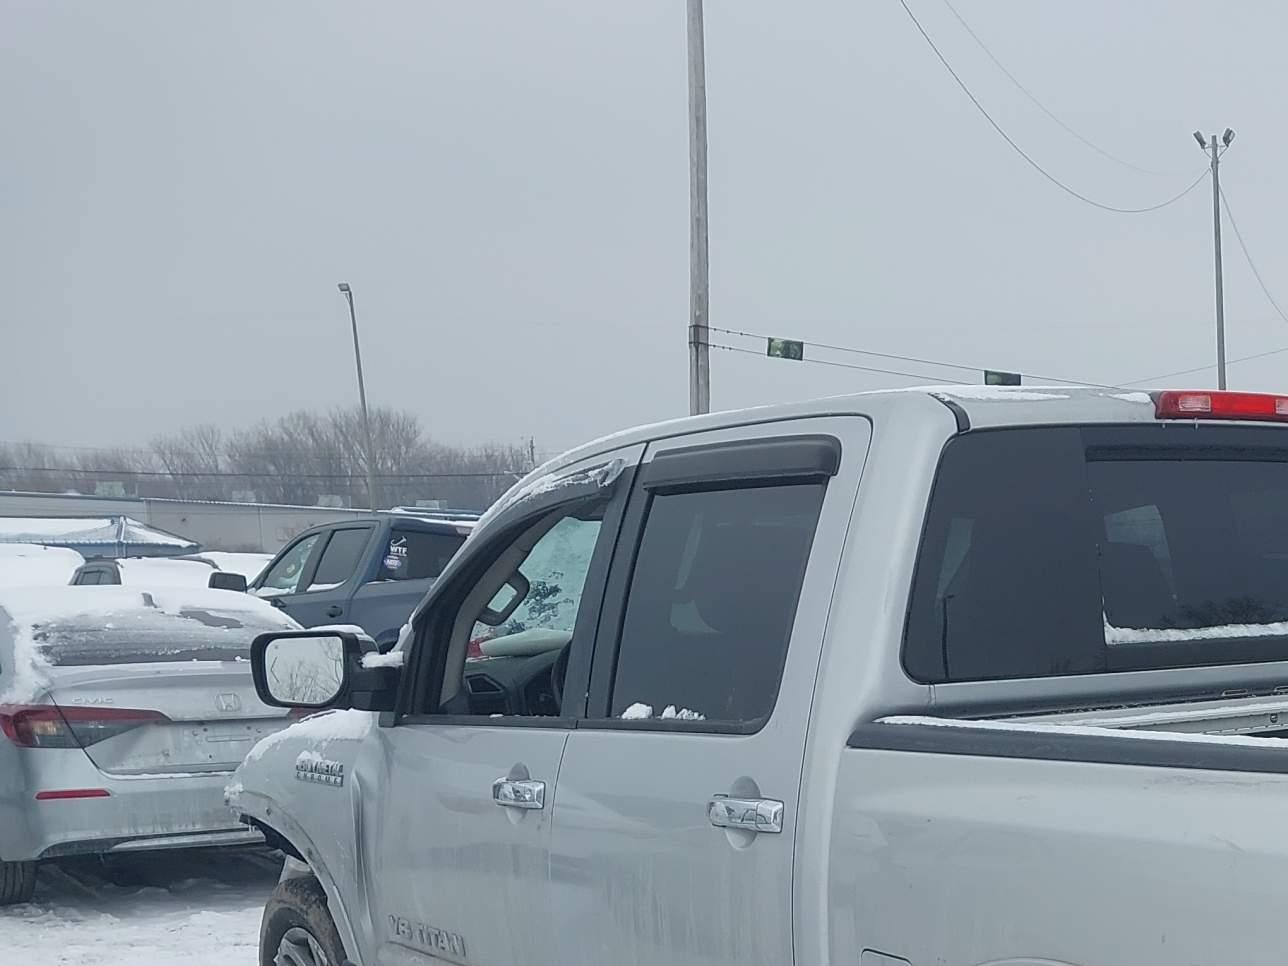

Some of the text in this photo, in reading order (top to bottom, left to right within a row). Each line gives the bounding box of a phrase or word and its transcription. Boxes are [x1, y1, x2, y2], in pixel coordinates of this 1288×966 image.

[390, 546, 408, 554] WTF
[71, 696, 113, 705] CIVIC
[416, 922, 467, 957] TITAN
